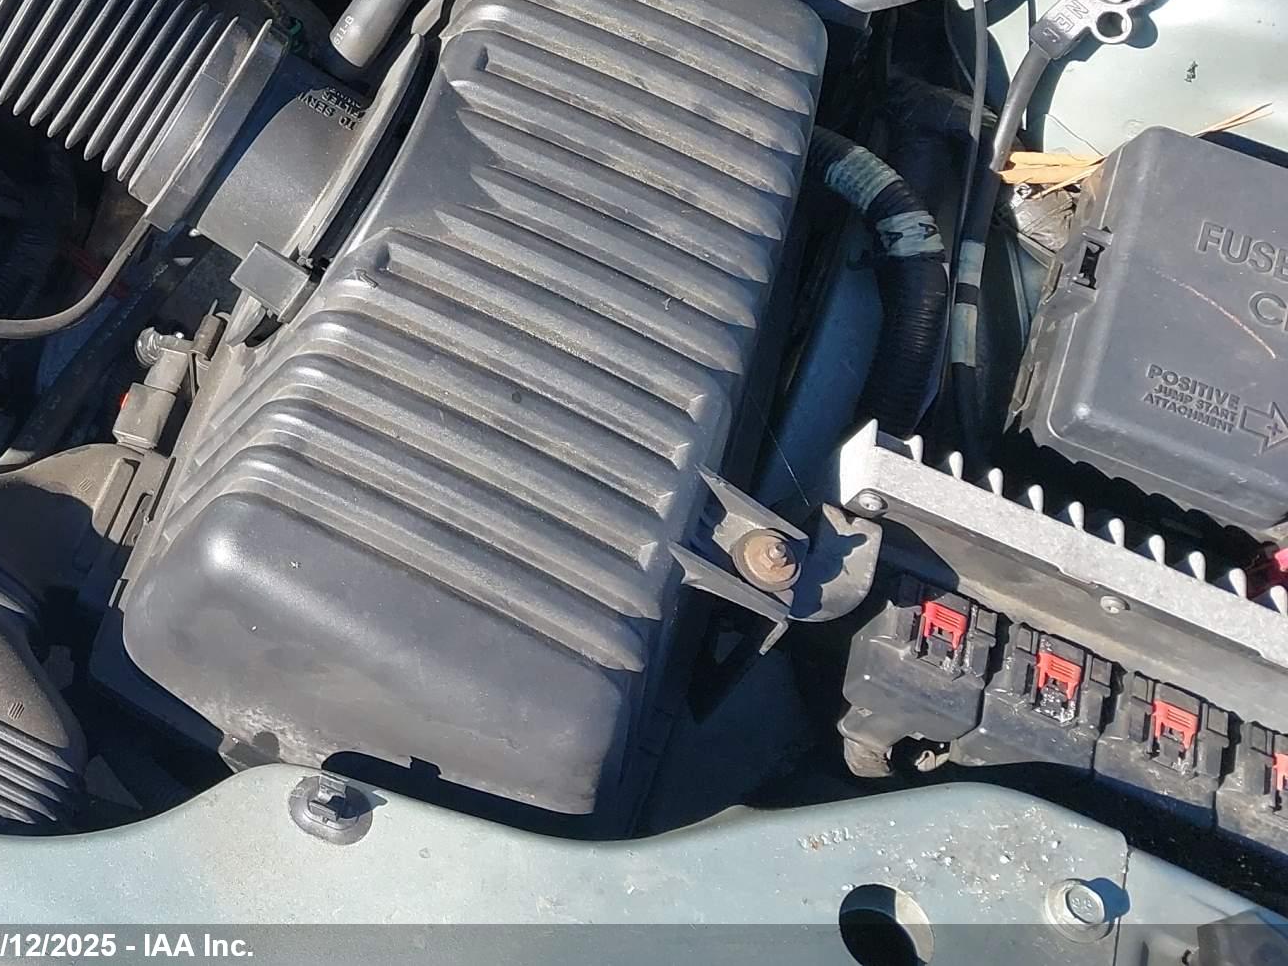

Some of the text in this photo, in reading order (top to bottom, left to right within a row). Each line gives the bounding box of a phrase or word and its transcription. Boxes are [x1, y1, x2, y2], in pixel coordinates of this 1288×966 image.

[1042, 0, 1089, 43] NEG
[319, 91, 362, 118] FILTER
[1146, 363, 1240, 411] POSITIVE
[1154, 384, 1237, 422] JUMP START
[1142, 393, 1235, 433] ATTACHMENT
